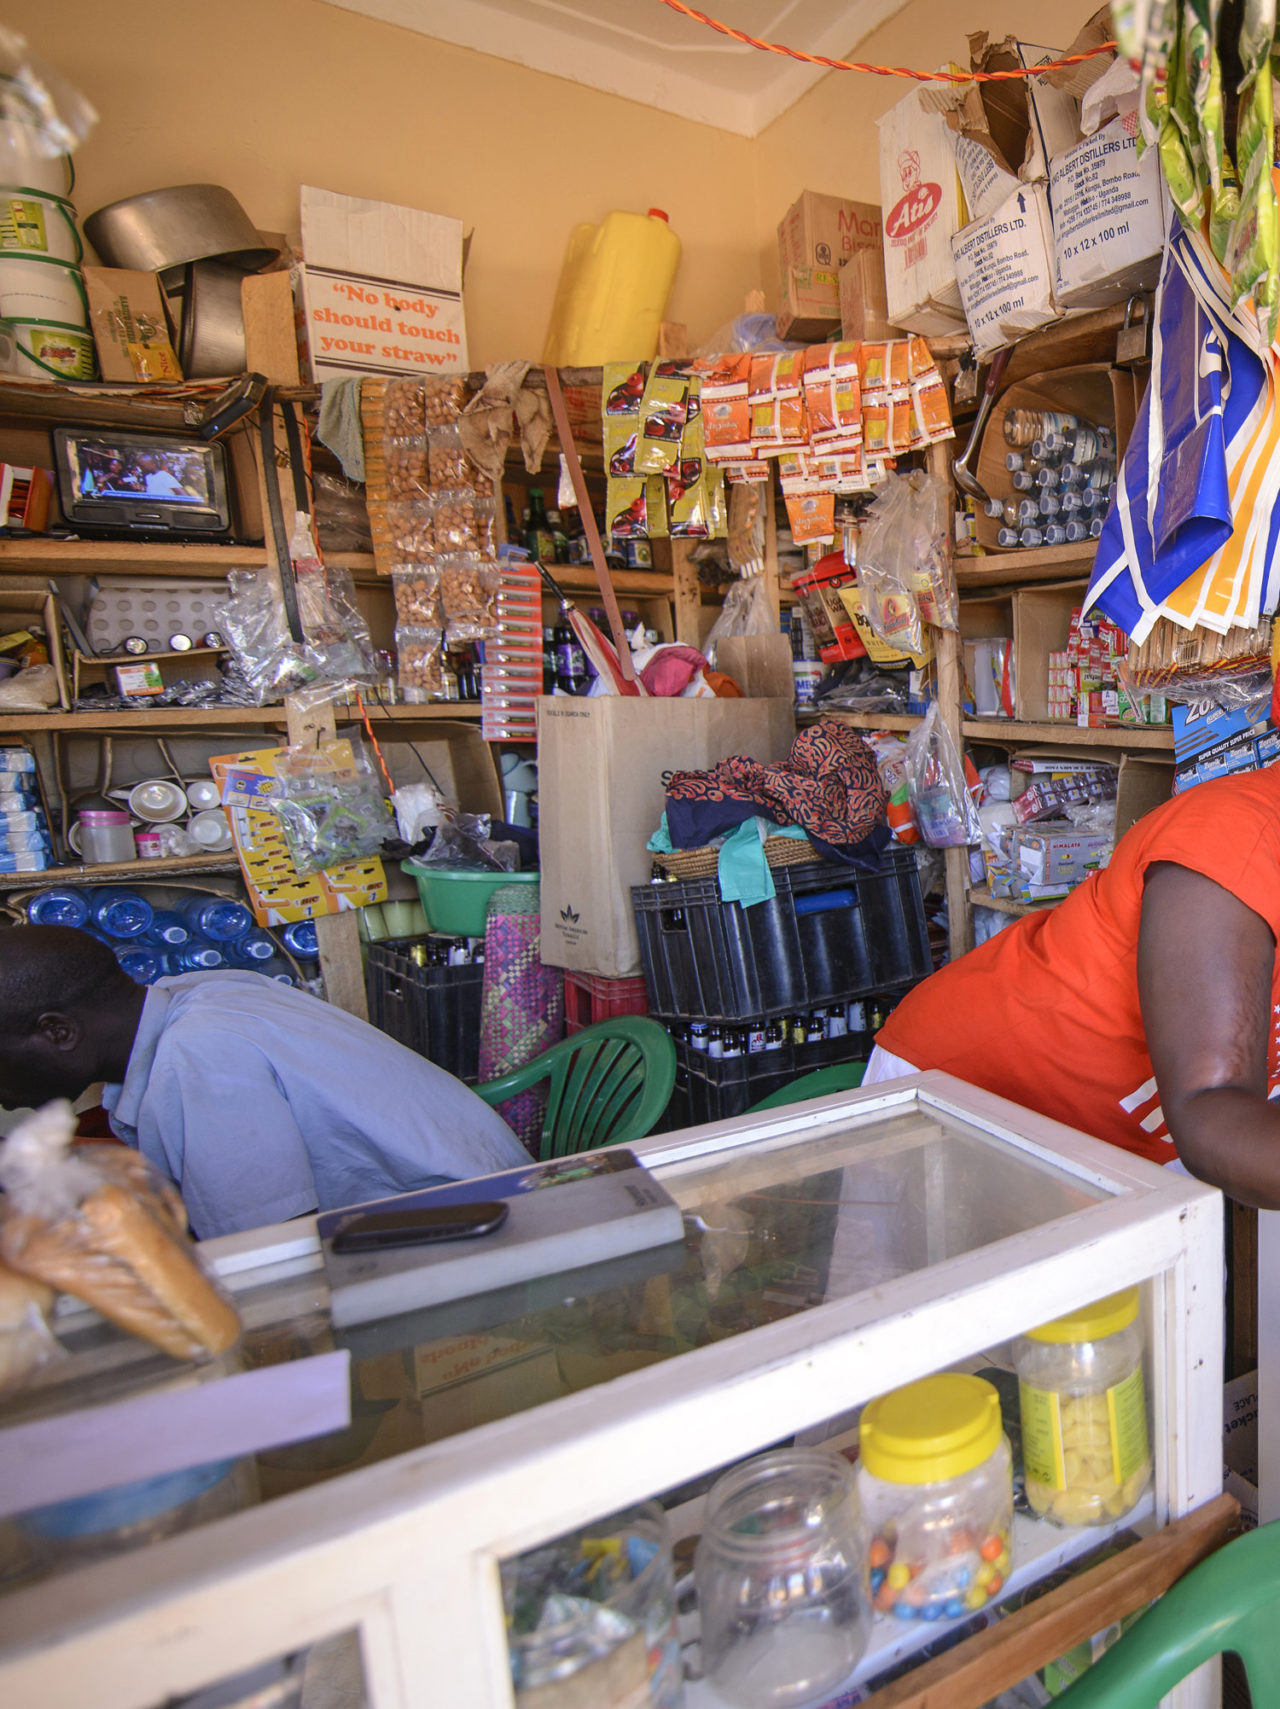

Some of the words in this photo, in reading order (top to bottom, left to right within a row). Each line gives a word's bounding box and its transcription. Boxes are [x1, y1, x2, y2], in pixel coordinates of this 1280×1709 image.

[1060, 156, 1079, 177] ALBERT
[1079, 140, 1120, 165] DISTILLERS
[1098, 186, 1119, 198] Uganda
[1102, 173, 1122, 186] Bombo
[960, 241, 977, 257] ALBERT
[976, 223, 1009, 248] DISTILLERS
[1009, 218, 1026, 232] LTD.
[1063, 247, 1073, 260] 10
[1073, 246, 1079, 255] x
[1080, 238, 1090, 251] 12
[1091, 236, 1097, 246] x
[1098, 227, 1115, 243] 100
[1117, 221, 1130, 236] ml
[383, 292, 439, 319] body
[985, 311, 994, 322] 12
[999, 301, 1012, 316] 100
[1012, 296, 1025, 309] ml
[312, 307, 393, 333] should
[397, 320, 461, 345] touch
[319, 335, 377, 355] your
[1198, 752, 1212, 761] SUPER
[1211, 742, 1230, 755] QUALITY
[1229, 734, 1242, 746] SUPER
[1242, 728, 1255, 739] PRICE
[367, 881, 384, 891] BIC
[300, 895, 320, 906] BIC
